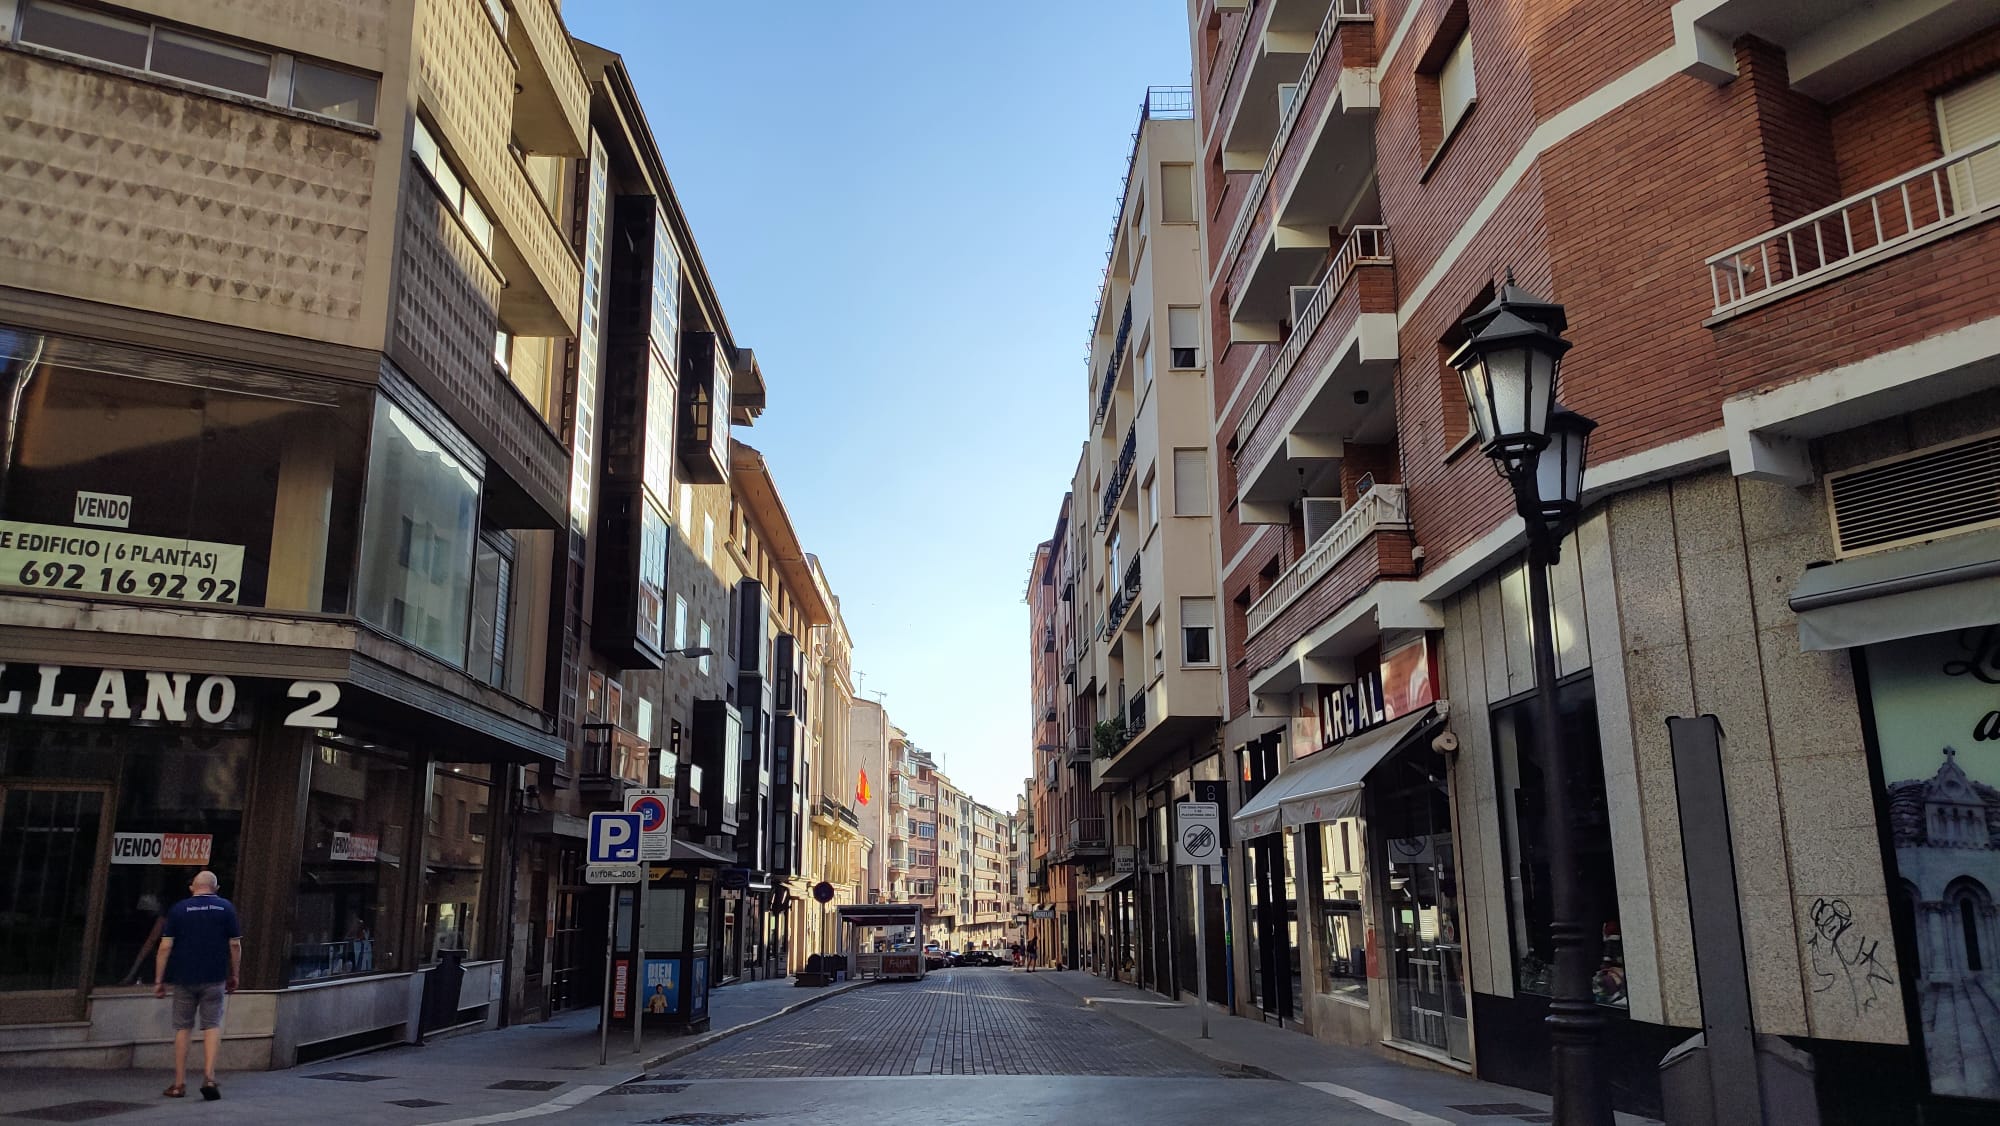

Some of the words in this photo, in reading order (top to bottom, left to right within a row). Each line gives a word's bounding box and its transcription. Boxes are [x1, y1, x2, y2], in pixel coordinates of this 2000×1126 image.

[77, 497, 129, 520] VENDO
[16, 532, 100, 558] EDIFICIO
[115, 543, 126, 560] 6
[130, 544, 218, 575] PLANTAS)
[18, 560, 86, 590] 692
[99, 567, 137, 594] 16
[147, 572, 188, 600] 92
[197, 577, 237, 603] 92
[283, 680, 342, 728] 2
[1323, 671, 1385, 745] ARGAL
[114, 837, 162, 858] VENDO
[179, 837, 189, 859] 16
[190, 837, 201, 859] 92
[201, 838, 212, 860] 92
[599, 818, 631, 858] P
